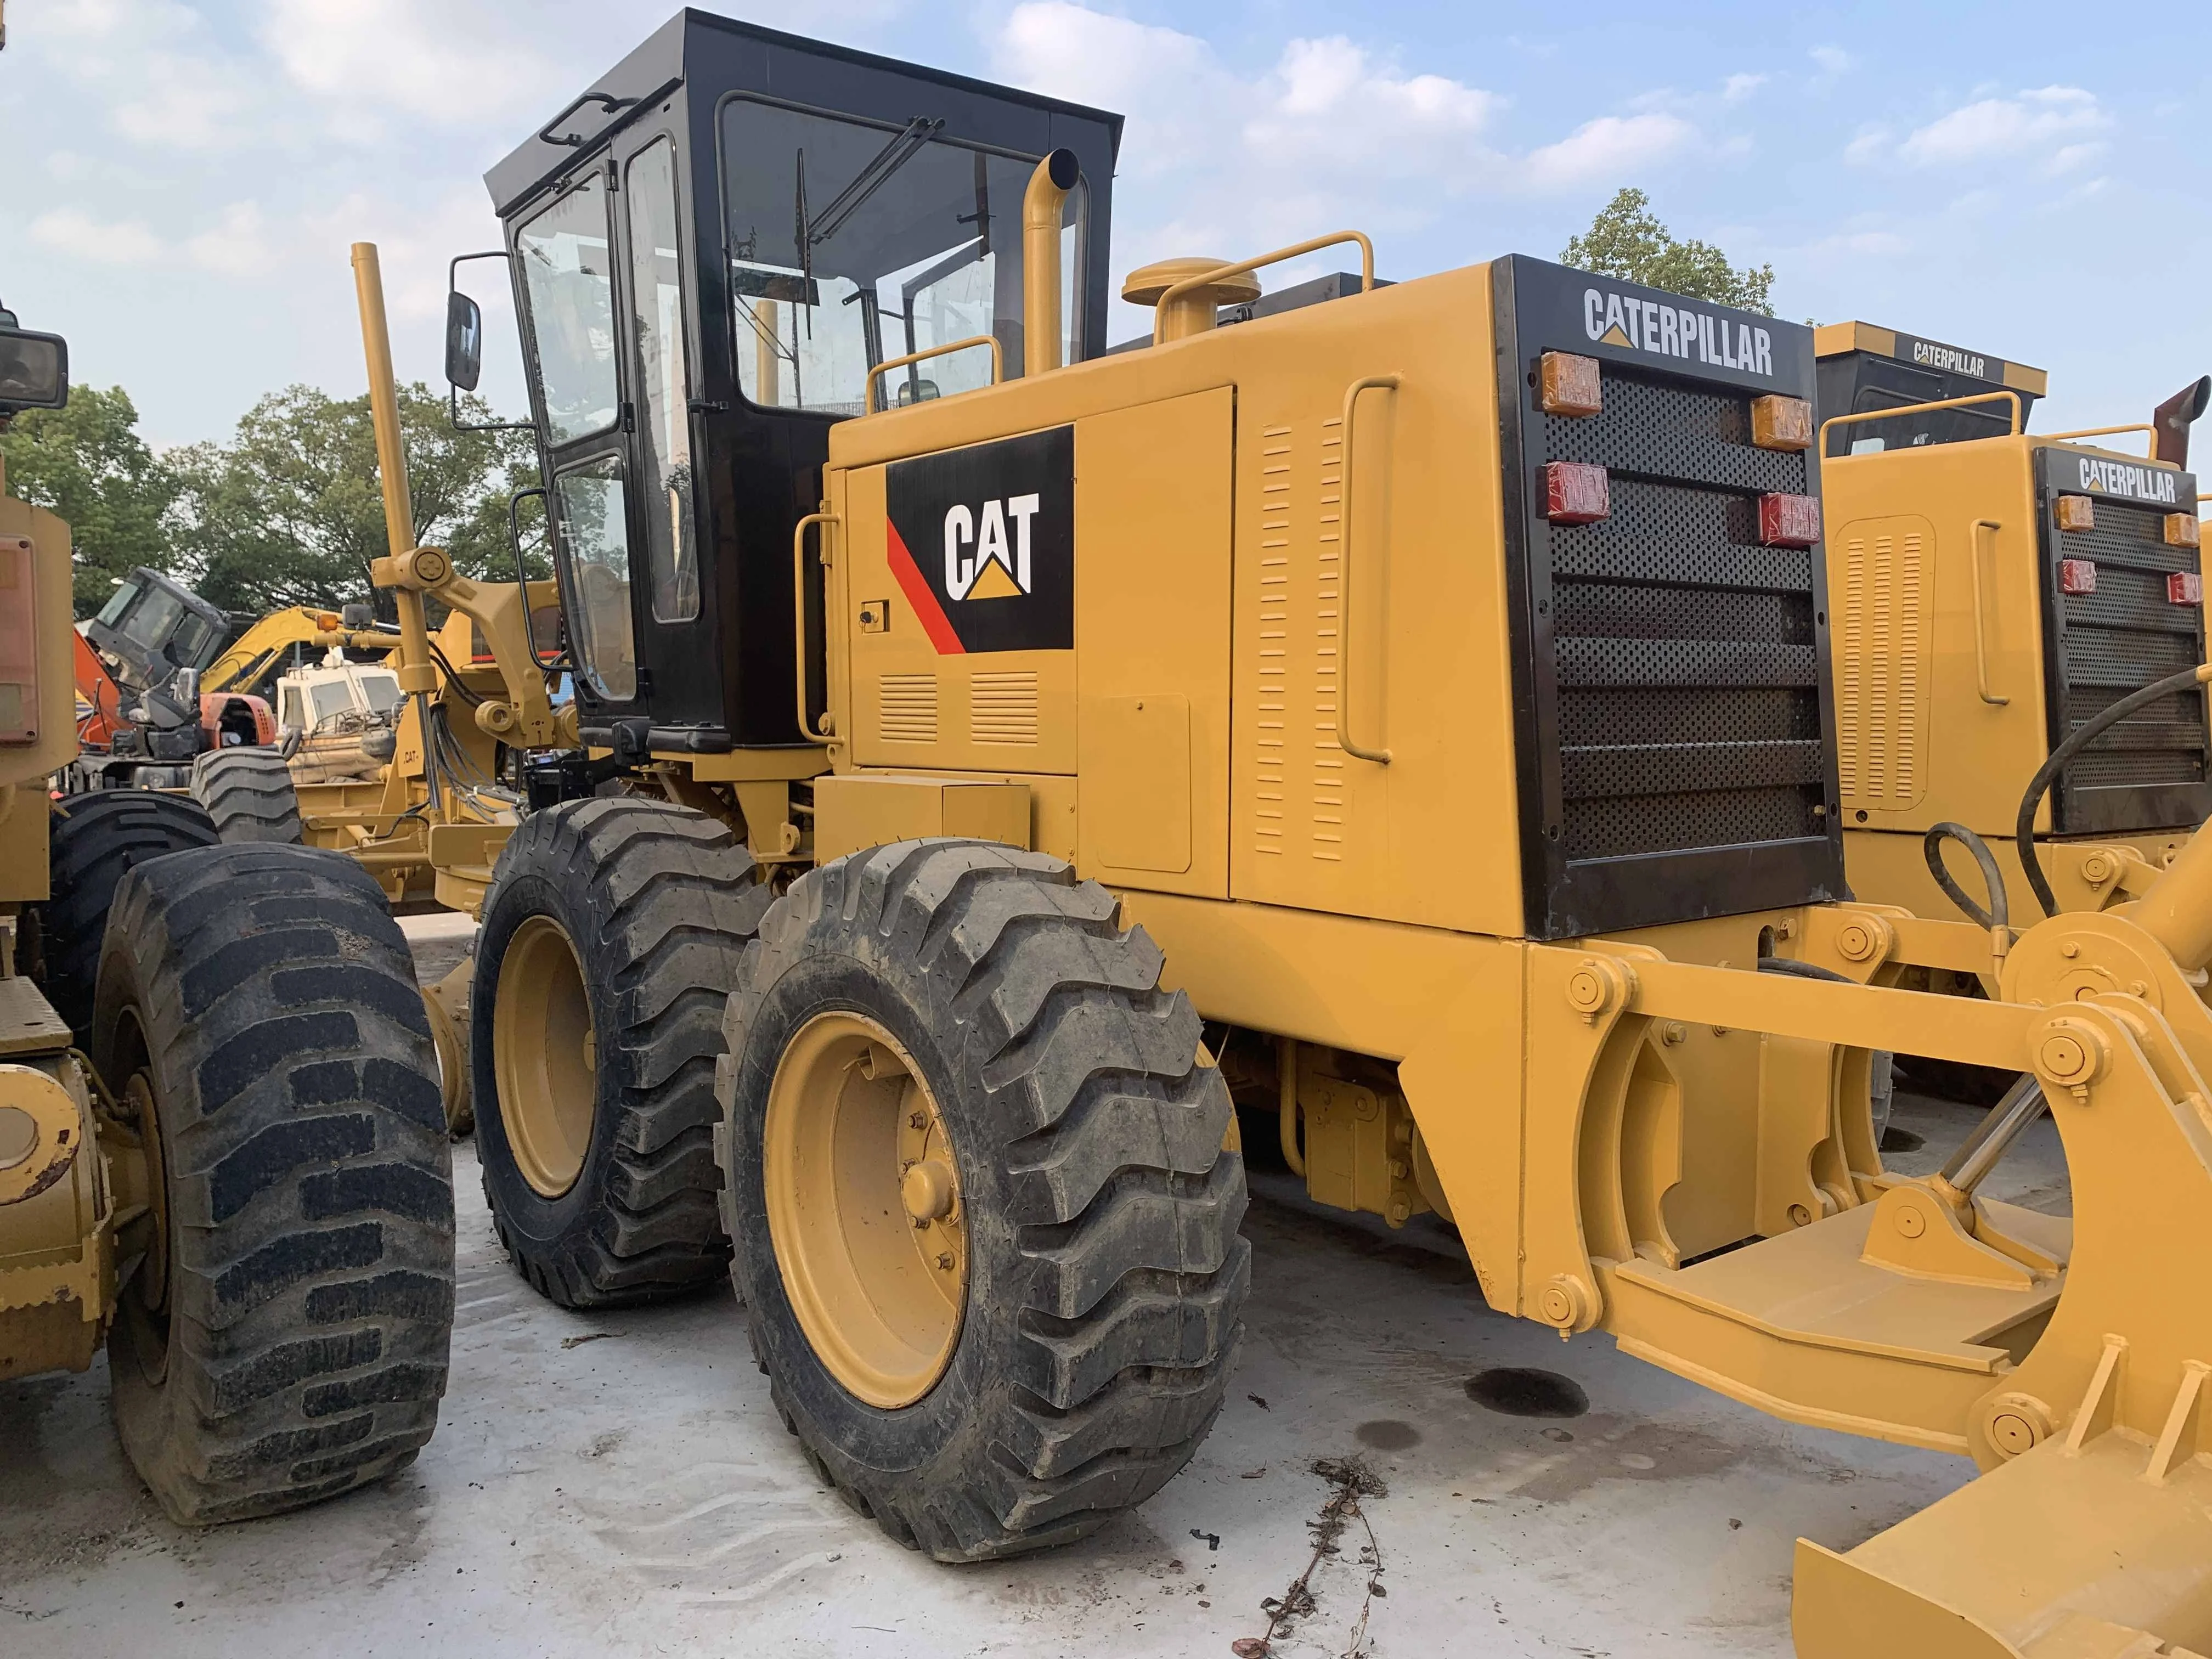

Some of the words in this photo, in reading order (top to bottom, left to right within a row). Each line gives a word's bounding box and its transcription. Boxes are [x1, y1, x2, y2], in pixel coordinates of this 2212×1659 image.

[1584, 289, 1773, 376] CATERPILLAR
[1914, 341, 1984, 377] CATERPILLAR
[2079, 458, 2176, 504] CATERPILLAR
[945, 493, 1039, 601] CAT
